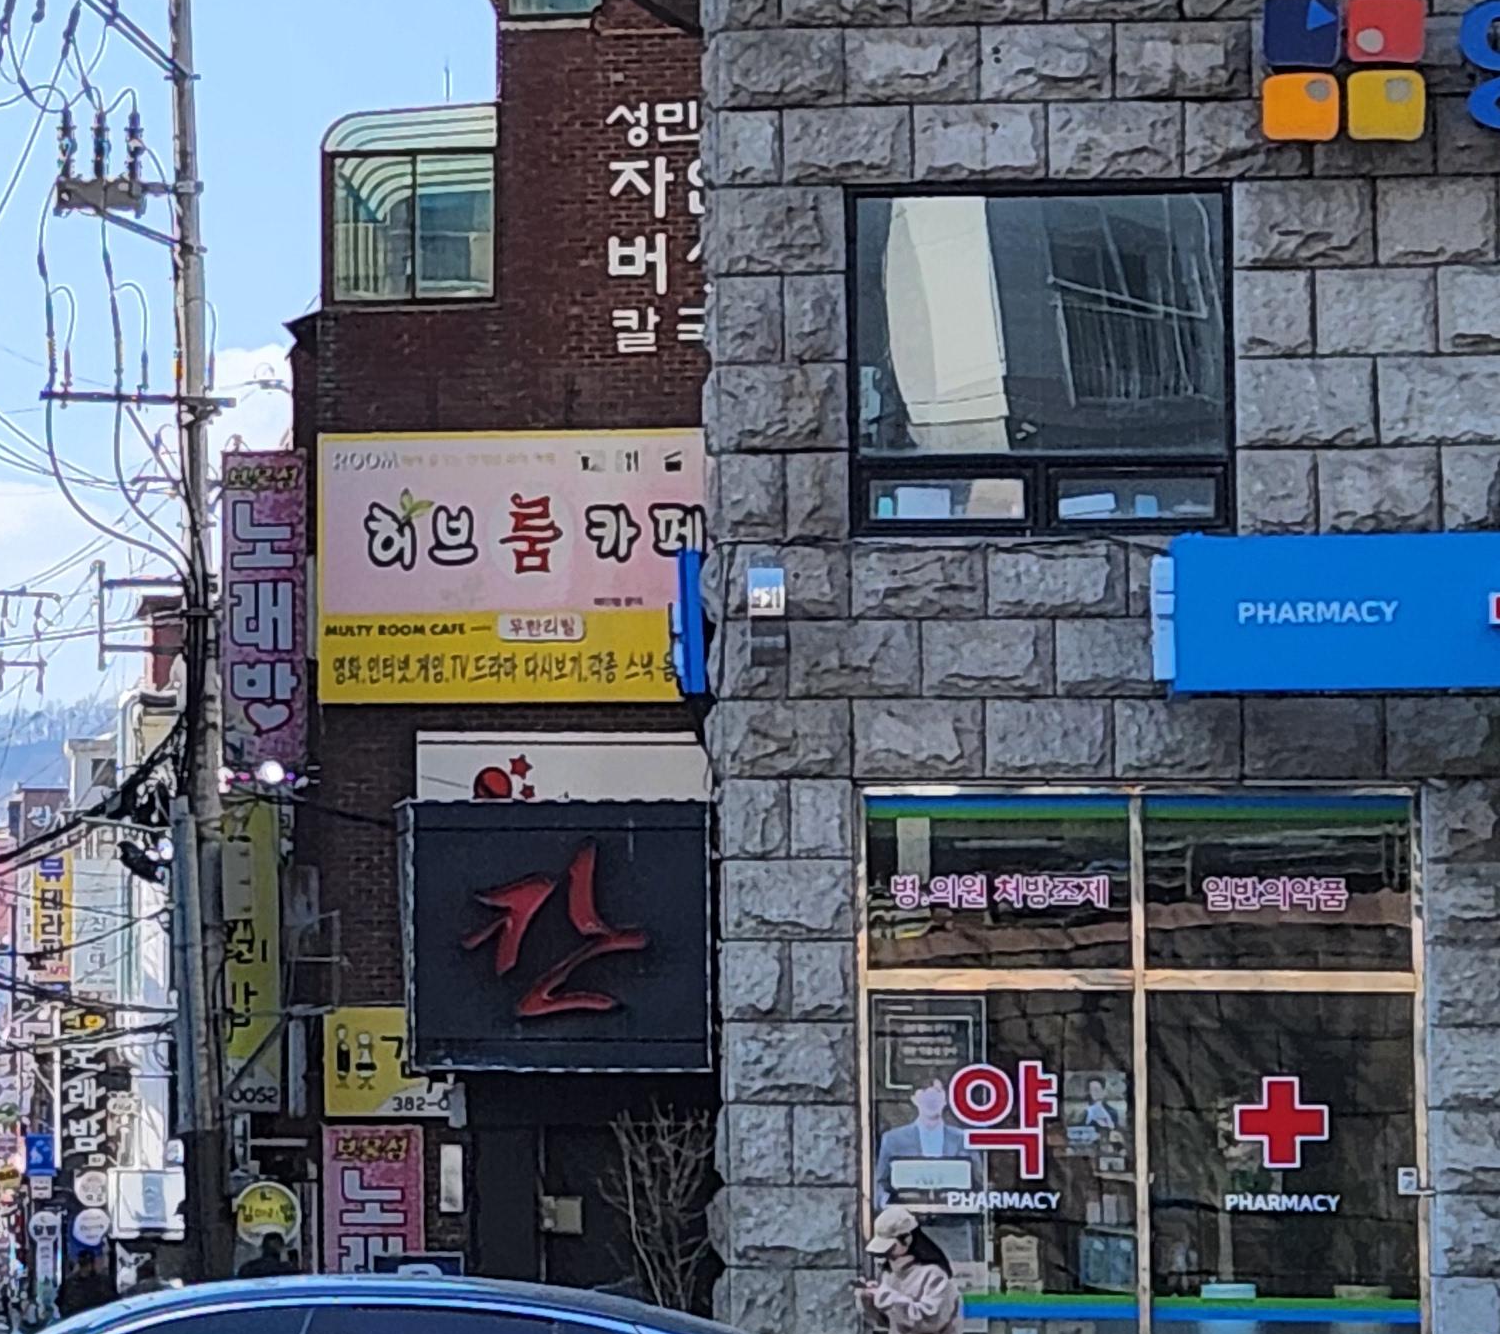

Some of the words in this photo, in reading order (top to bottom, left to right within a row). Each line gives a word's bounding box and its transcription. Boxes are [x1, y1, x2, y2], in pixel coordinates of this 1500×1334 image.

[498, 493, 565, 575] 룸
[584, 503, 708, 563] 카페
[1238, 600, 1399, 624] PHARMACY
[377, 624, 426, 636] ROOM
[429, 623, 466, 635] CAFE
[890, 874, 988, 909] 병.의원
[993, 873, 1110, 909] 처방조제
[1202, 876, 1350, 911] 일반의약품
[949, 1060, 1059, 1180] 약
[946, 1190, 1061, 1210] PHARMACY
[1225, 1192, 1341, 1213] PHARMACY
